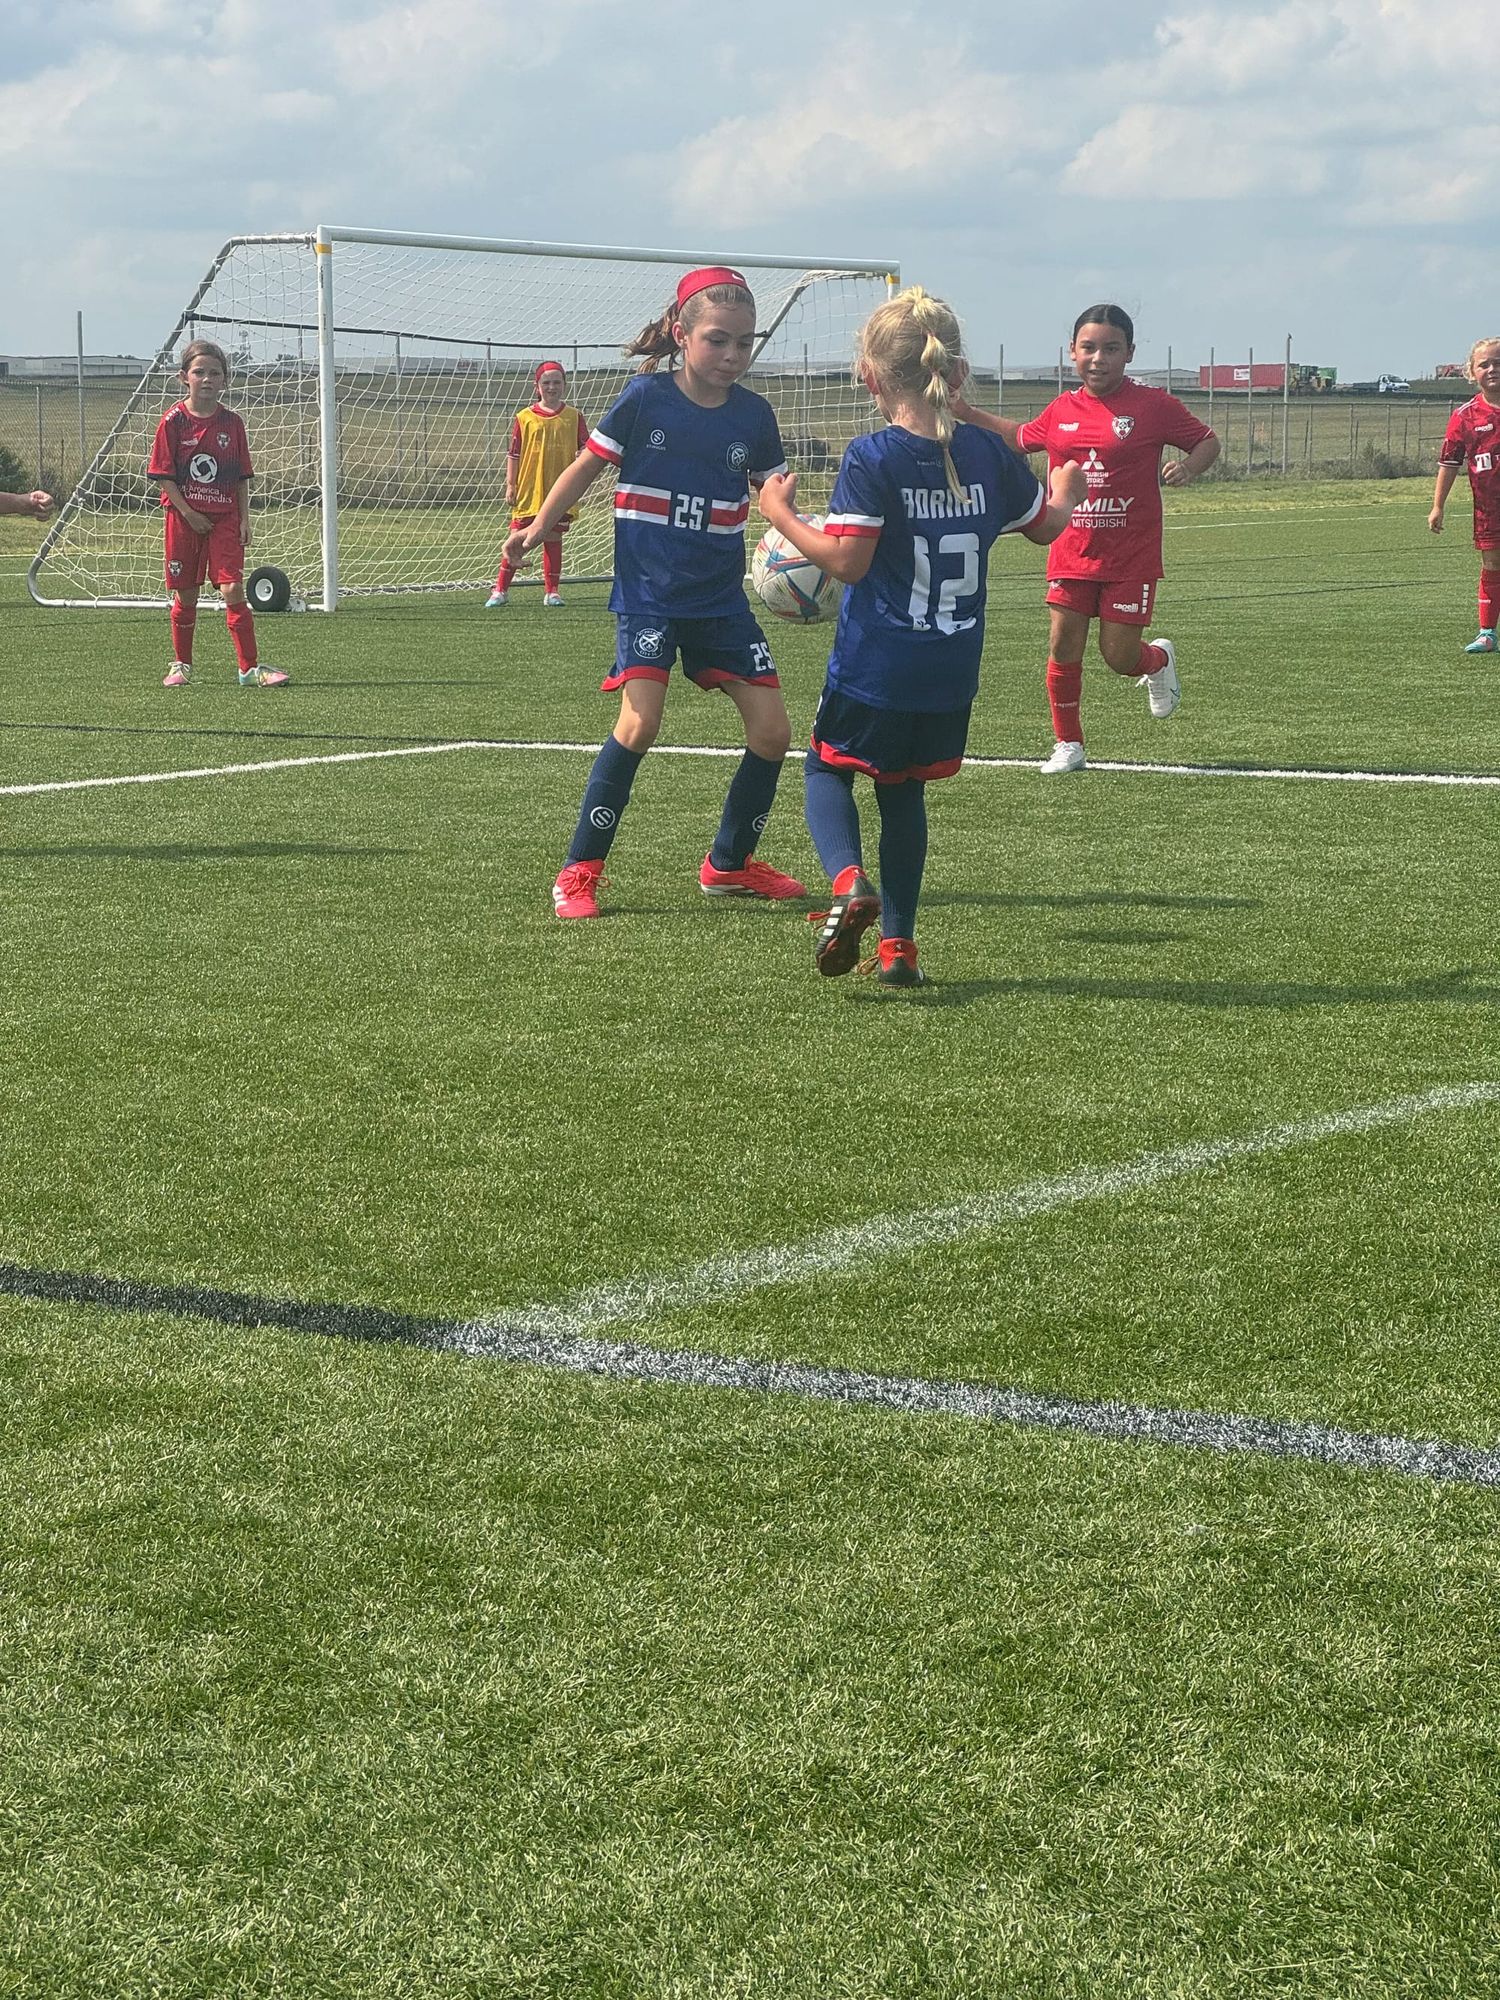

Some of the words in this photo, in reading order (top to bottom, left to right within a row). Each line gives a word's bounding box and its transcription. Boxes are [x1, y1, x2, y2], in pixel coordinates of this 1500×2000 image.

[673, 493, 705, 531] 25
[1073, 497, 1135, 512] AMILY
[1072, 518, 1128, 528] MITSUBISHI
[907, 532, 980, 635] 12
[750, 643, 775, 672] 25
